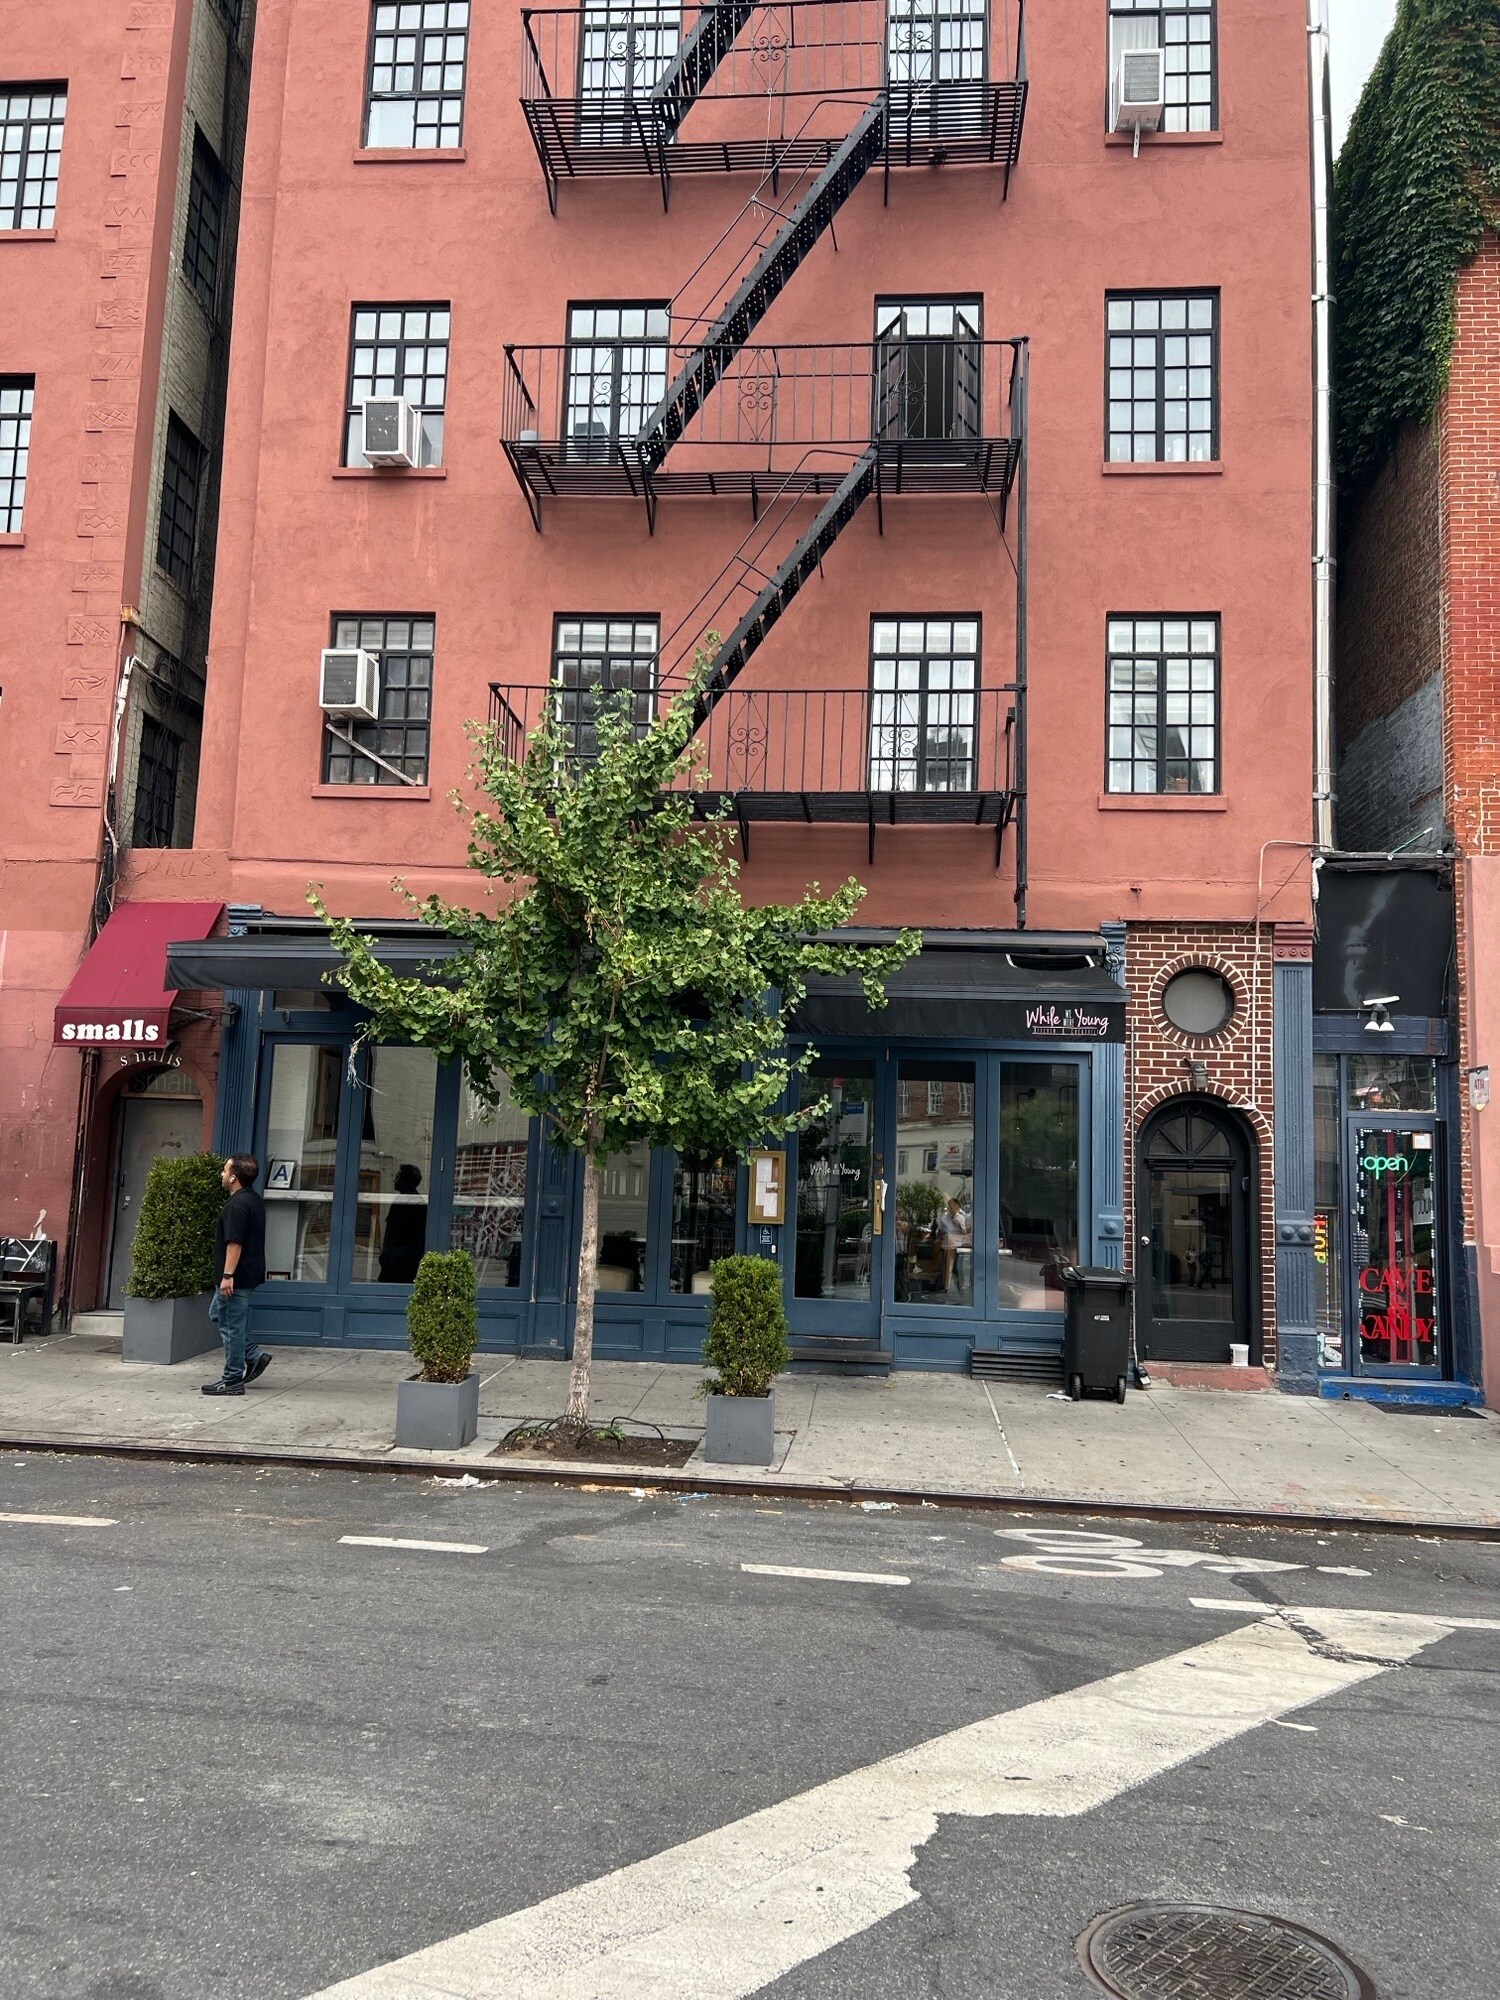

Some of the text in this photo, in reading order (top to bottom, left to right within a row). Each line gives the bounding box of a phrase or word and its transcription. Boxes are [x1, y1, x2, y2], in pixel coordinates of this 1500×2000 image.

[61, 1019, 159, 1041] smalls
[1026, 1005, 1061, 1029] While
[1074, 1007, 1109, 1036] Young
[272, 1164, 288, 1181] A
[839, 1162, 861, 1181] Young
[1363, 1156, 1408, 1180] open
[1358, 1267, 1432, 1294] CAVE
[1358, 1314, 1436, 1342] CANDY
